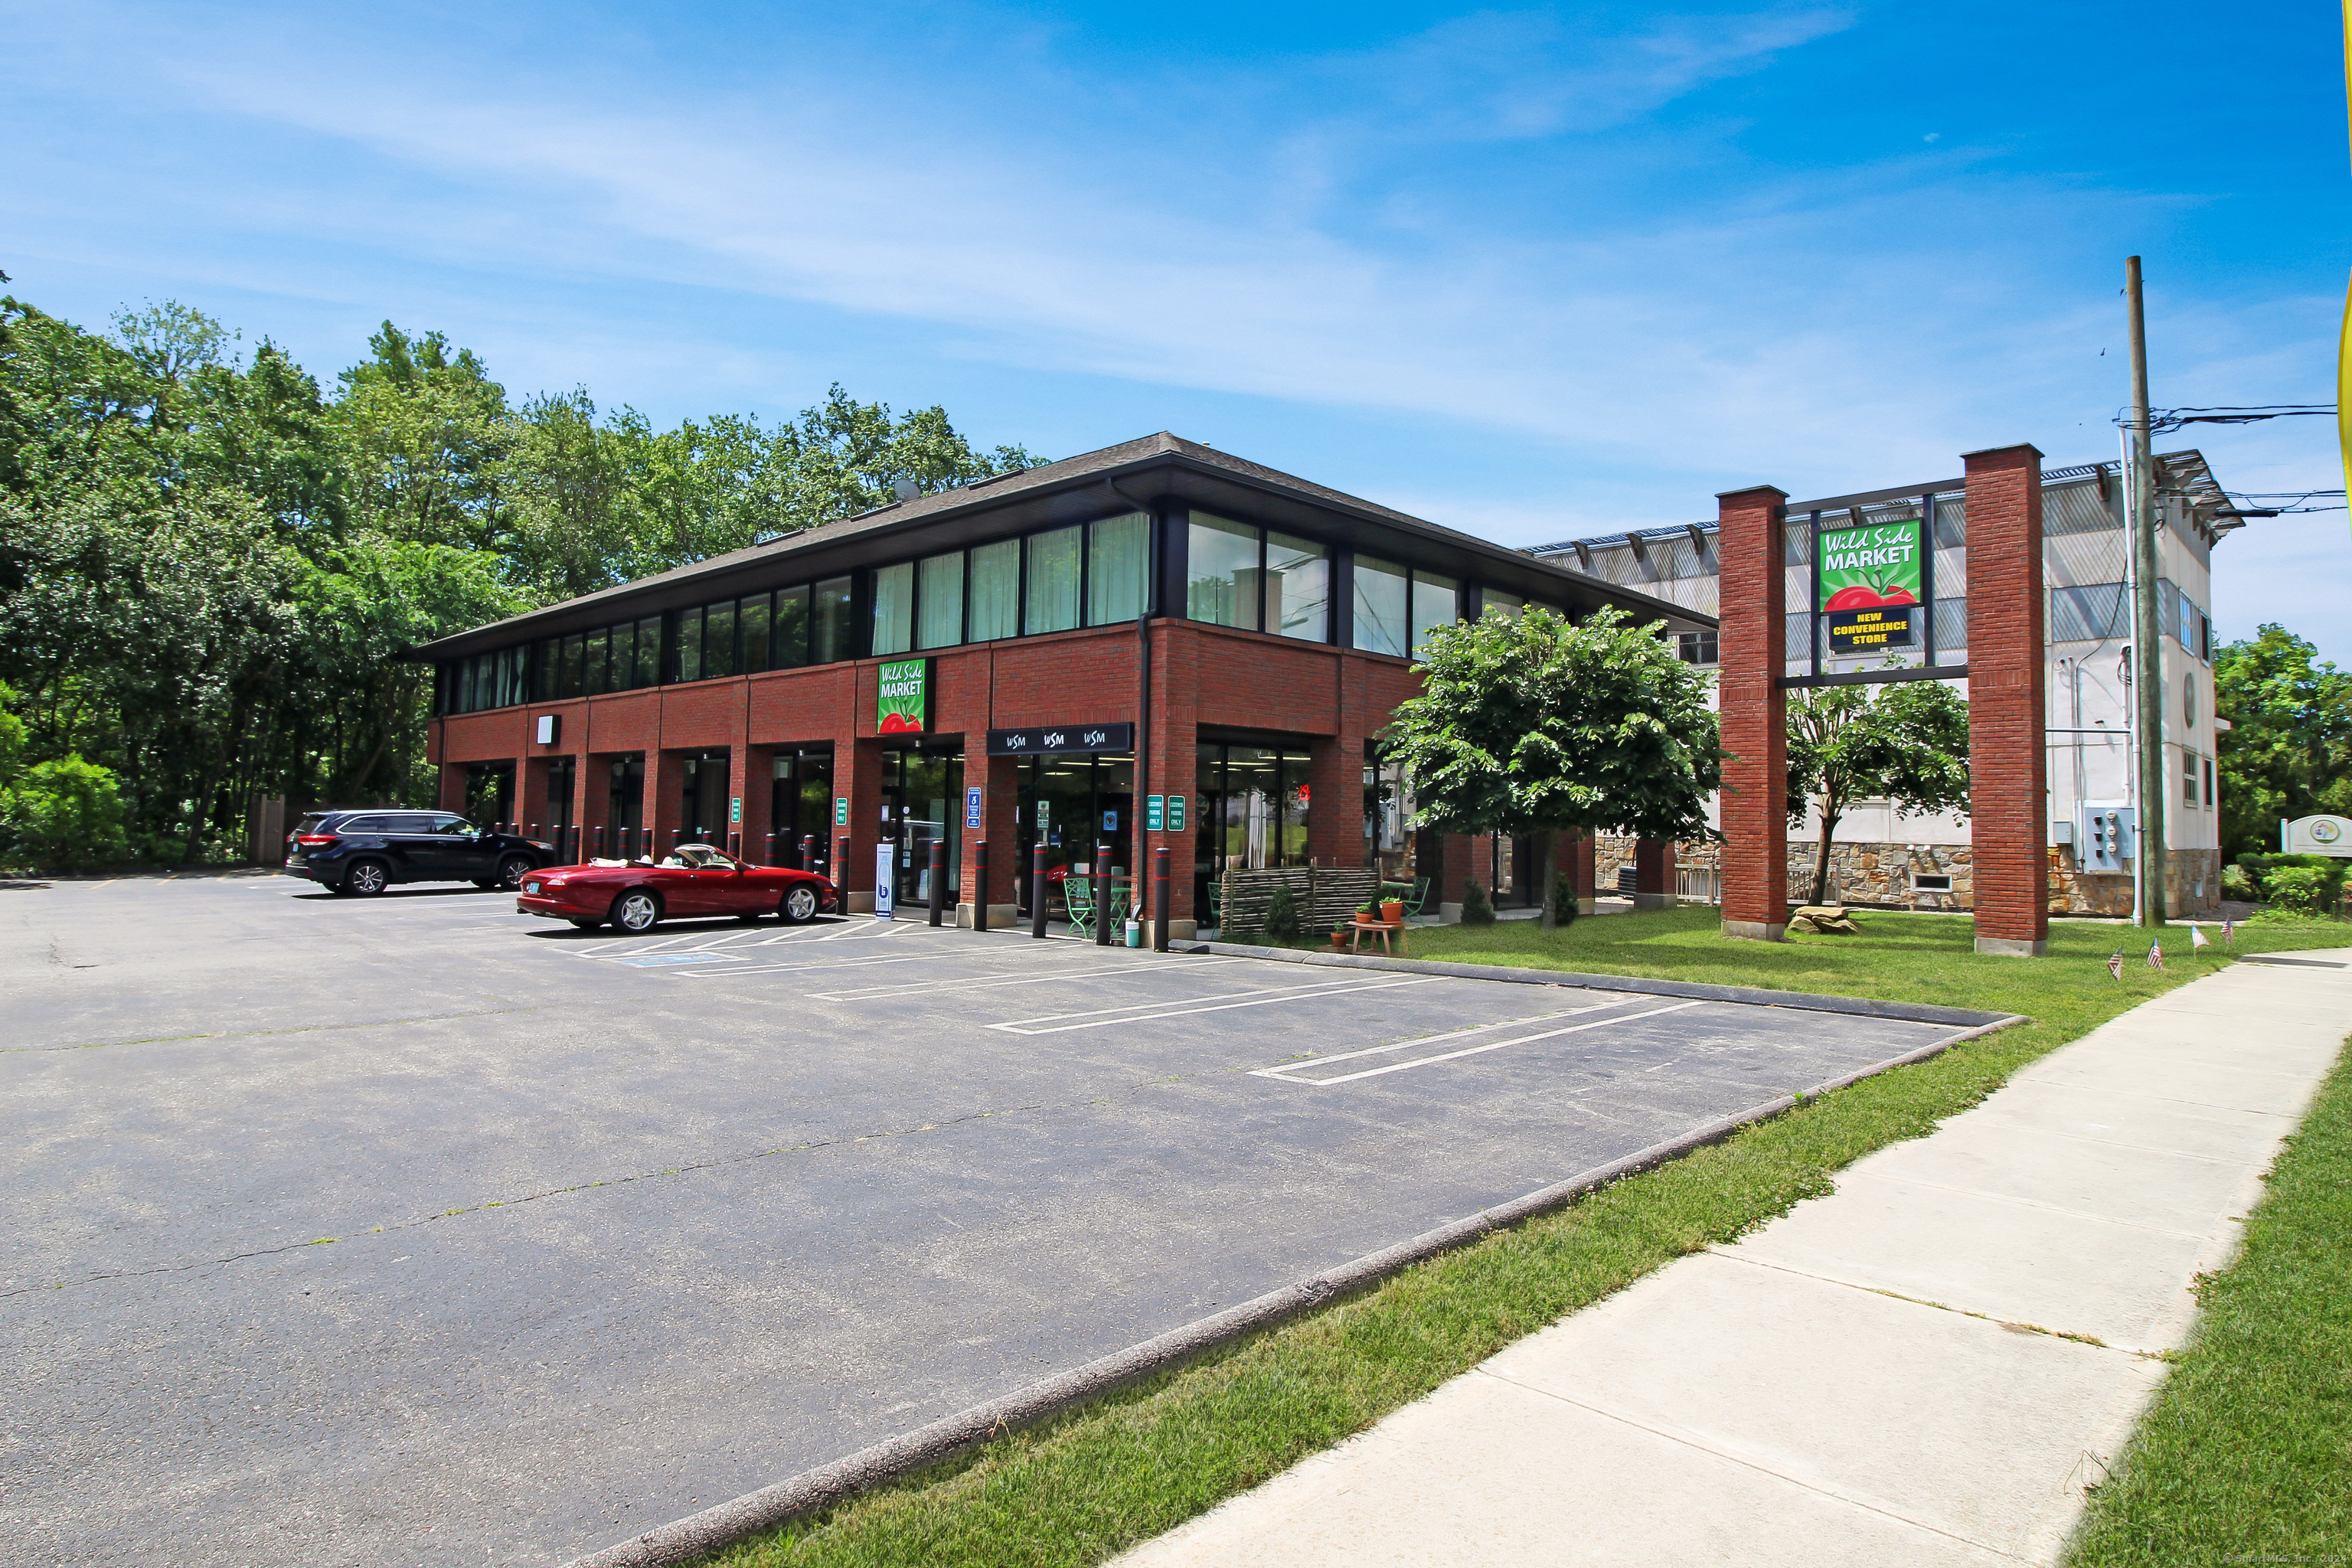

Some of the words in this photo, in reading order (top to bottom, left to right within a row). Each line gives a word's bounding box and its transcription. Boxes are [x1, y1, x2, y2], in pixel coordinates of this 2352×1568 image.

[1825, 530, 1870, 553] Wild
[1873, 524, 1914, 548] Side
[1824, 544, 1914, 571] MARKET
[1857, 612, 1883, 622] NEW
[1833, 621, 1908, 635] CONVENIENCE
[1852, 633, 1887, 645] STORE
[882, 665, 902, 682] Wild
[903, 662, 923, 681] Side
[880, 680, 923, 698] MARKET
[1007, 734, 1026, 750] WSM
[1044, 732, 1064, 748] WSM
[1084, 730, 1105, 746] WSM
